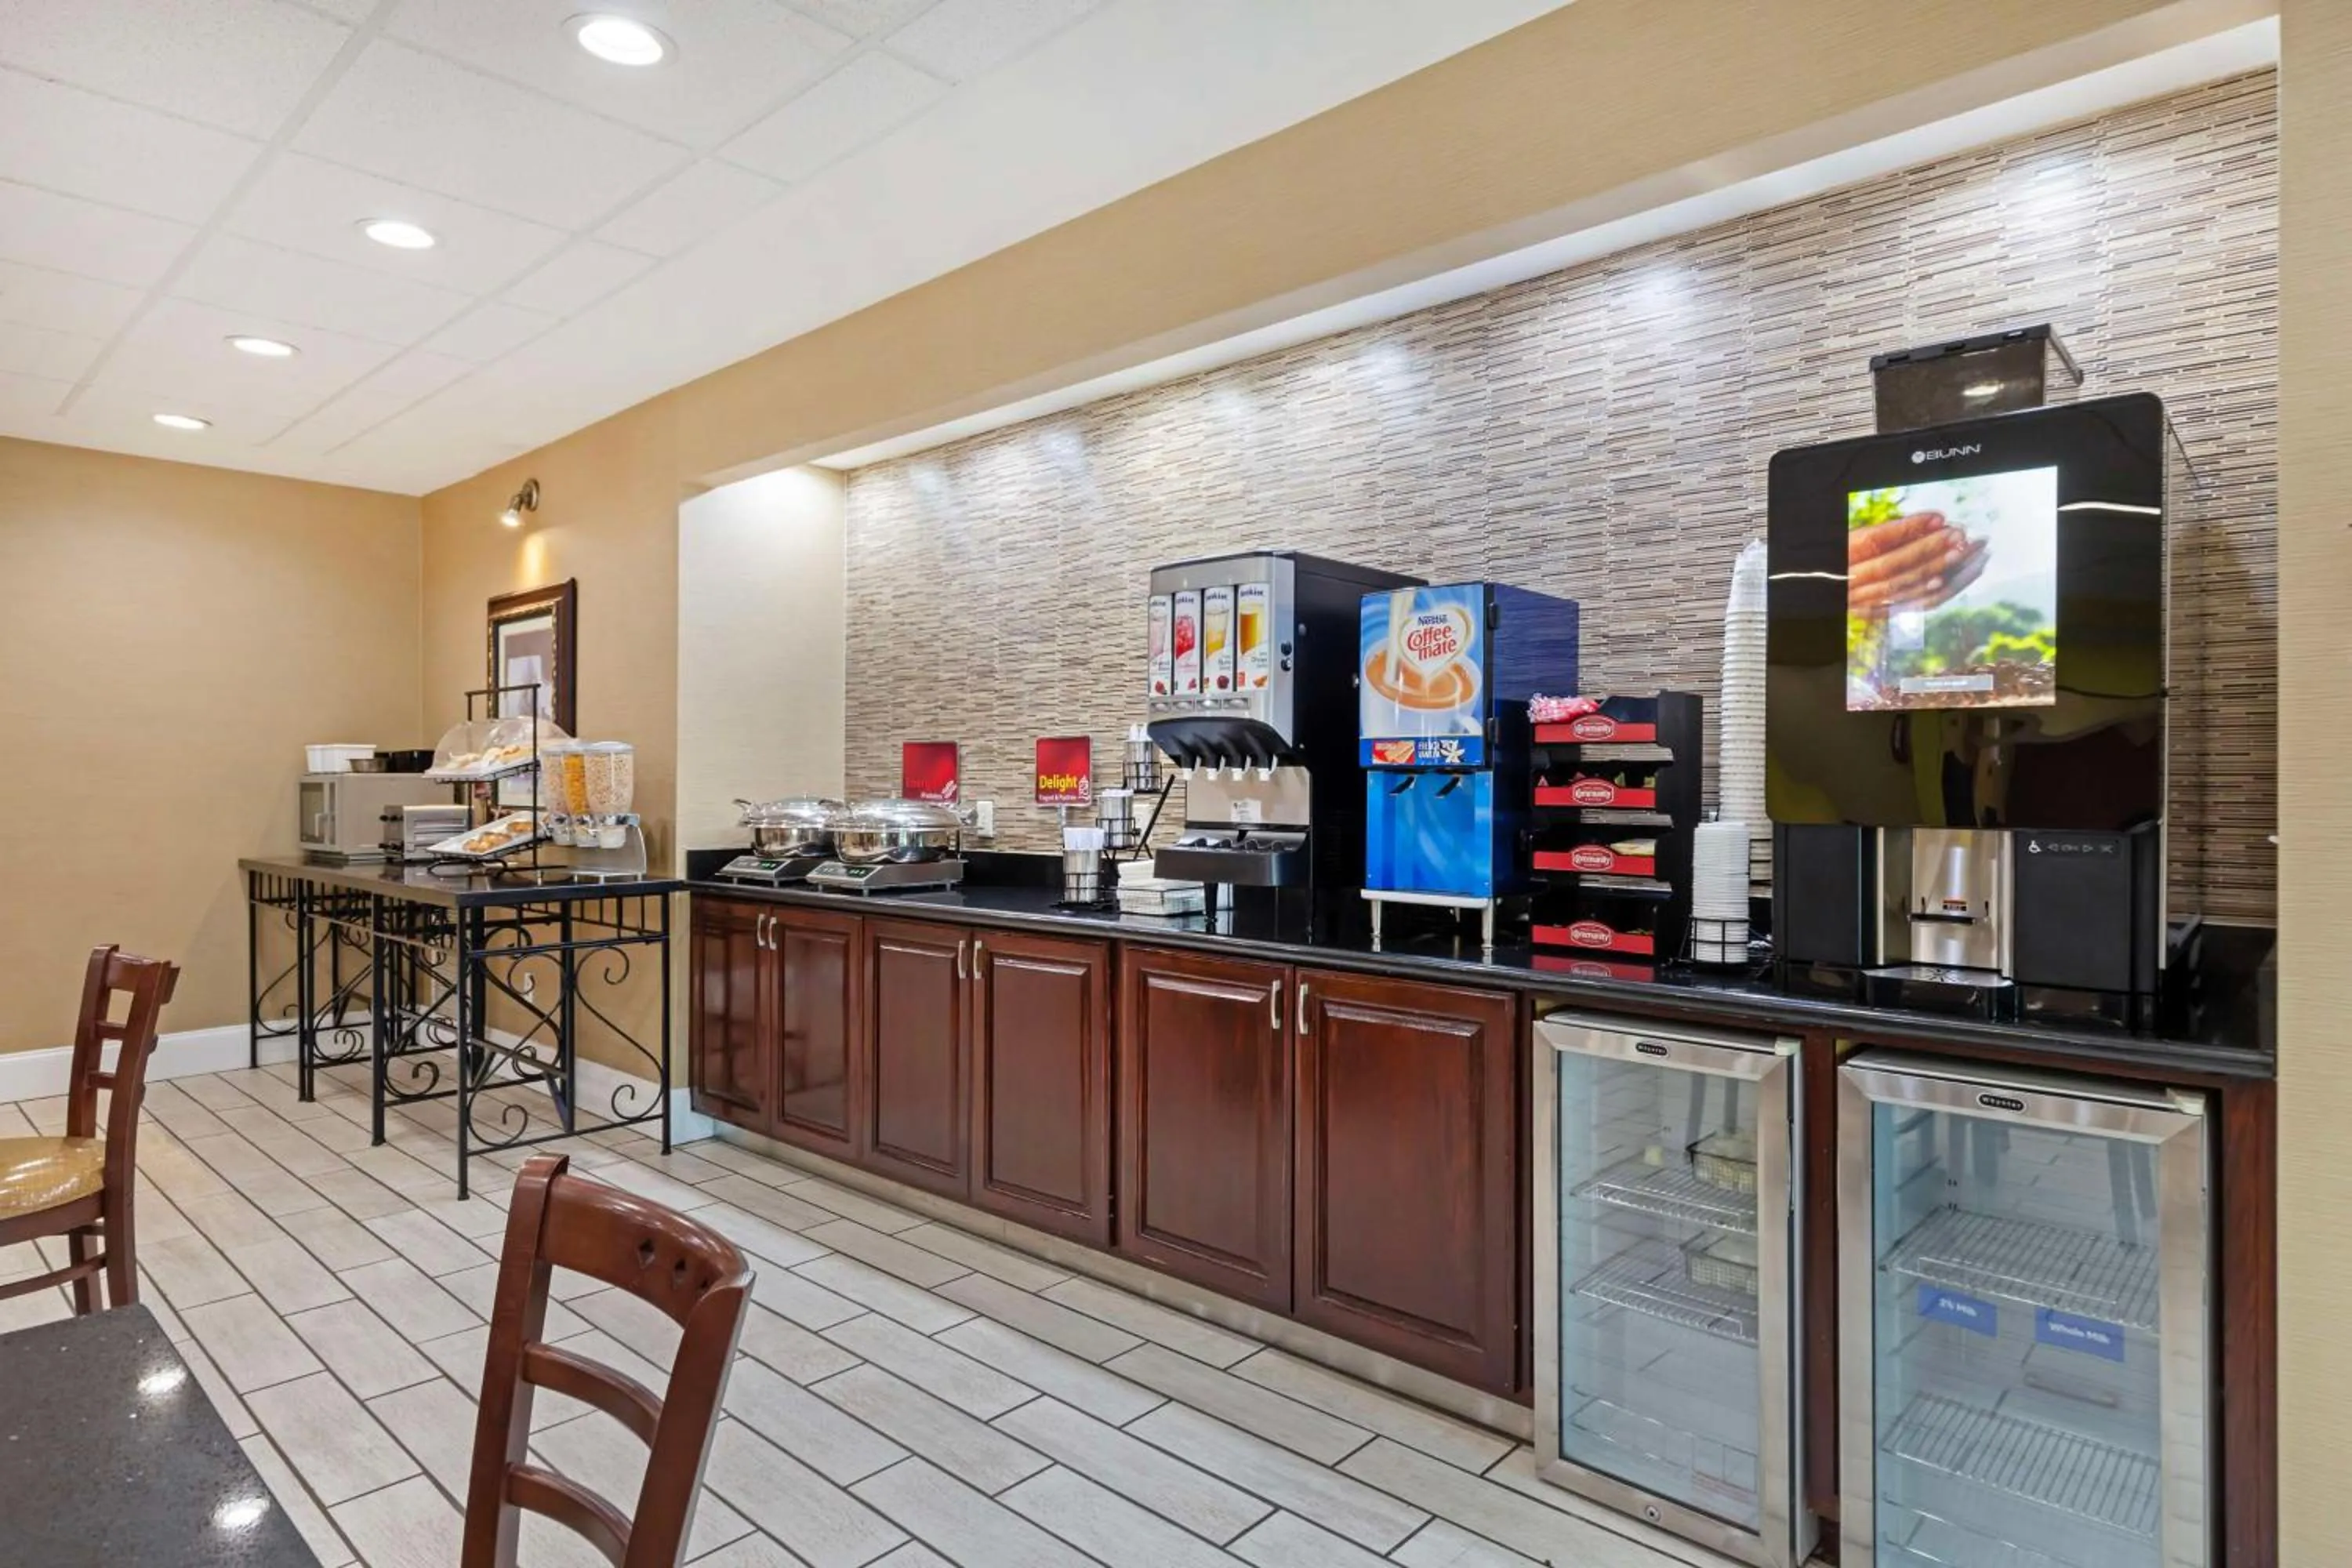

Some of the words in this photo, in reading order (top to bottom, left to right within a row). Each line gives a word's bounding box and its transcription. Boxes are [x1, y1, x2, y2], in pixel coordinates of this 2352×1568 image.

[1926, 444, 1981, 459] BUNN
[1418, 639, 1457, 661] mate
[1039, 774, 1078, 793] Delight
